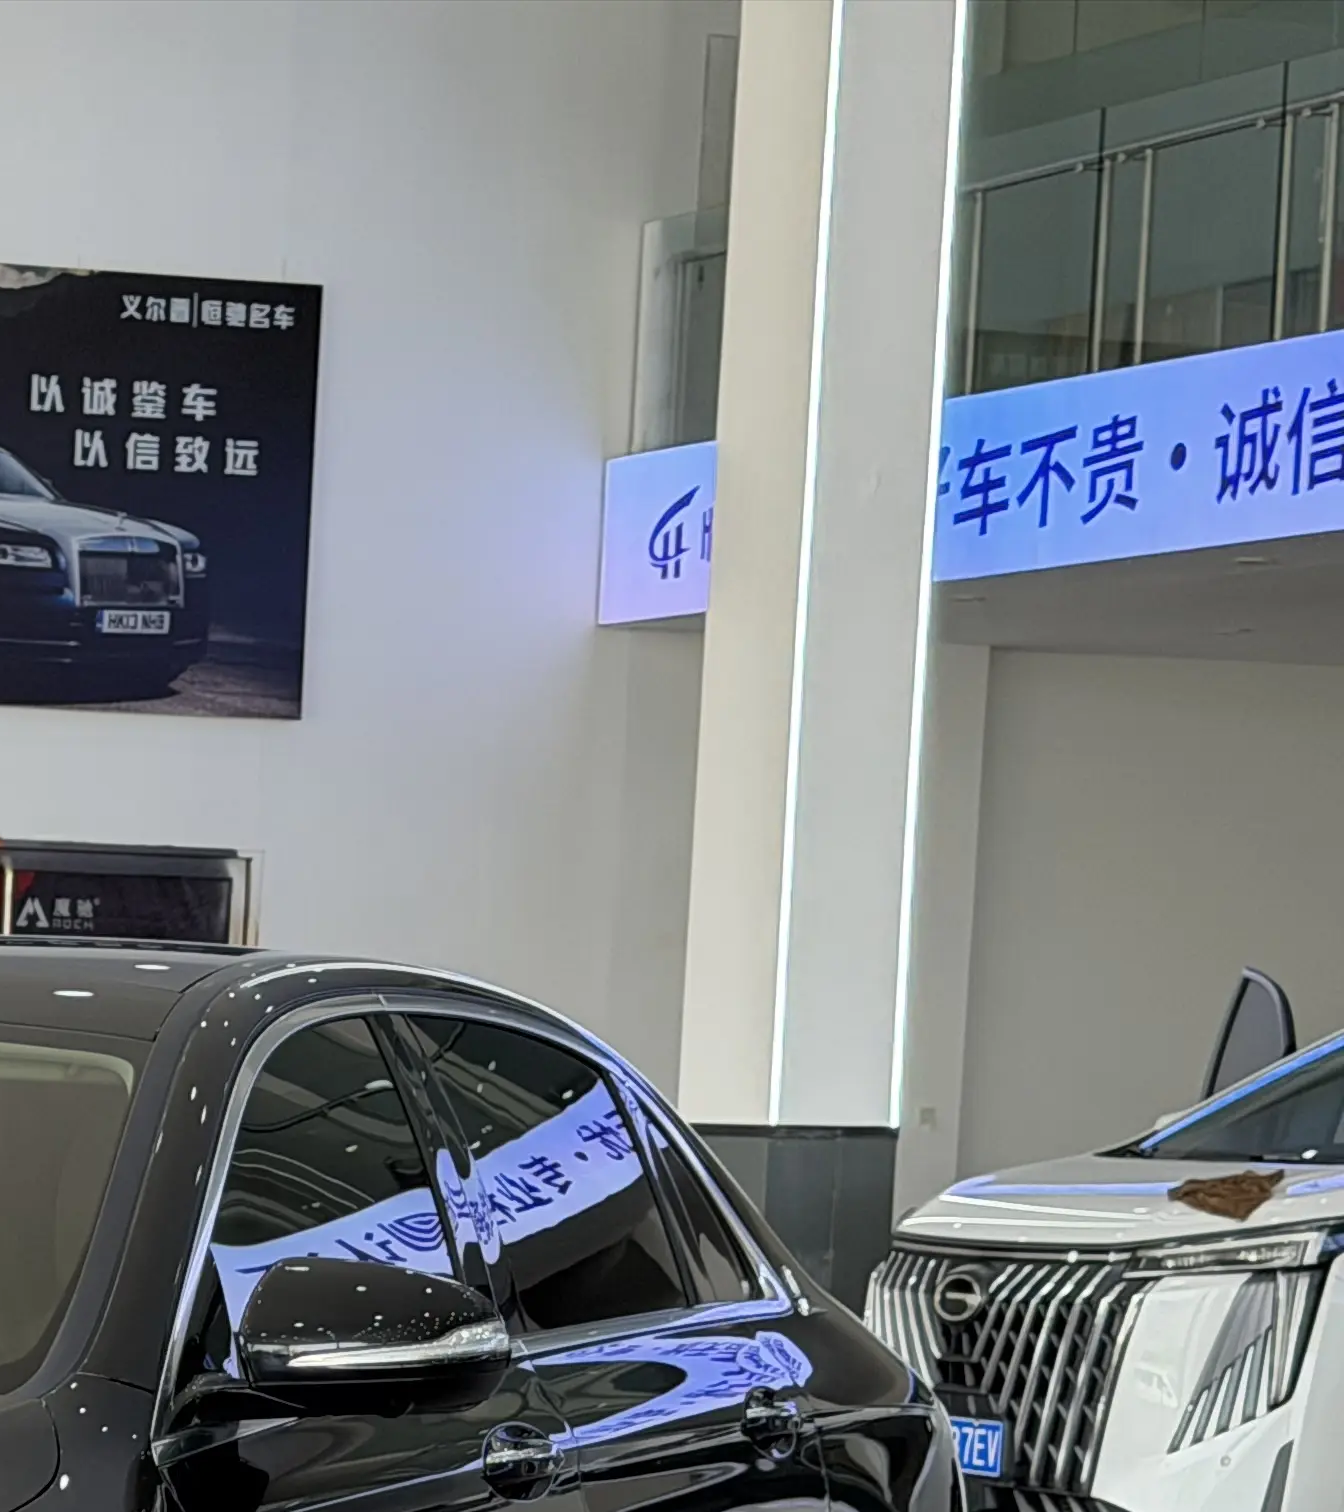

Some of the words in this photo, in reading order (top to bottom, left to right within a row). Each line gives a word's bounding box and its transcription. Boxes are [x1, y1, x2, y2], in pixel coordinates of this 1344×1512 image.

[29, 373, 218, 421] 以诚鉴车
[73, 428, 260, 476] 以信致远
